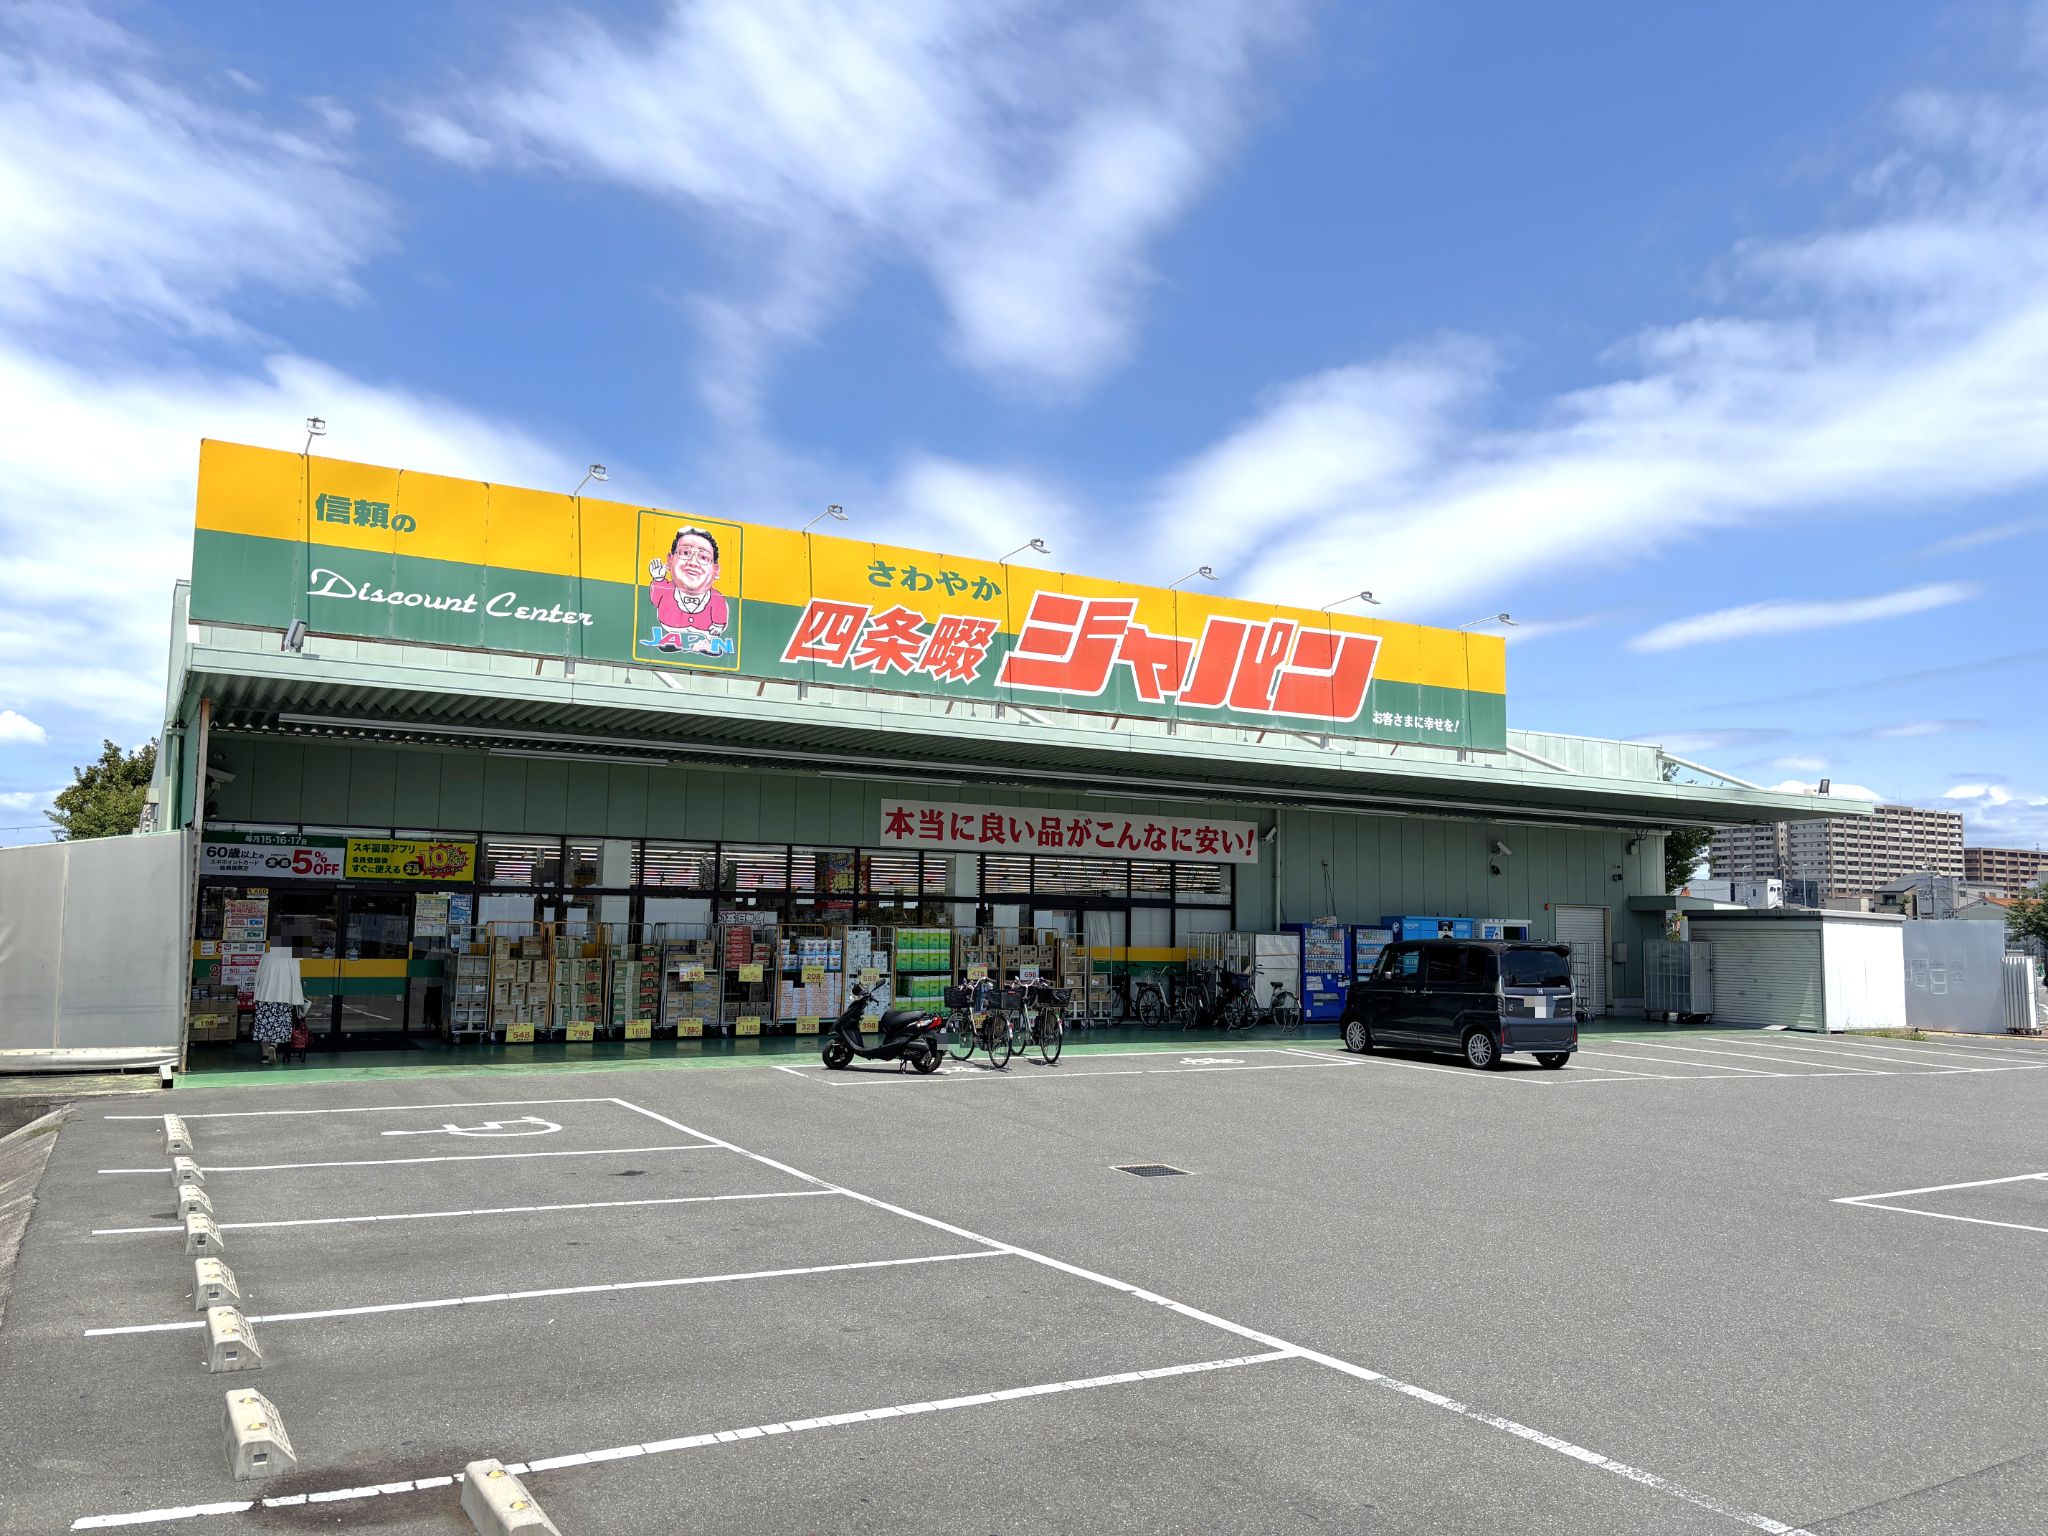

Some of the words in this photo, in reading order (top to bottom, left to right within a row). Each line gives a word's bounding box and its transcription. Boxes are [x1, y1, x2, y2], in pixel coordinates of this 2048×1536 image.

[315, 493, 416, 533] 信頼の
[306, 568, 478, 613] Discount
[485, 592, 593, 626] Center
[867, 560, 1002, 602] さわやか
[639, 627, 735, 654] JAPAN
[993, 590, 1382, 723] ジャパン
[206, 846, 265, 859] 60歳以上の
